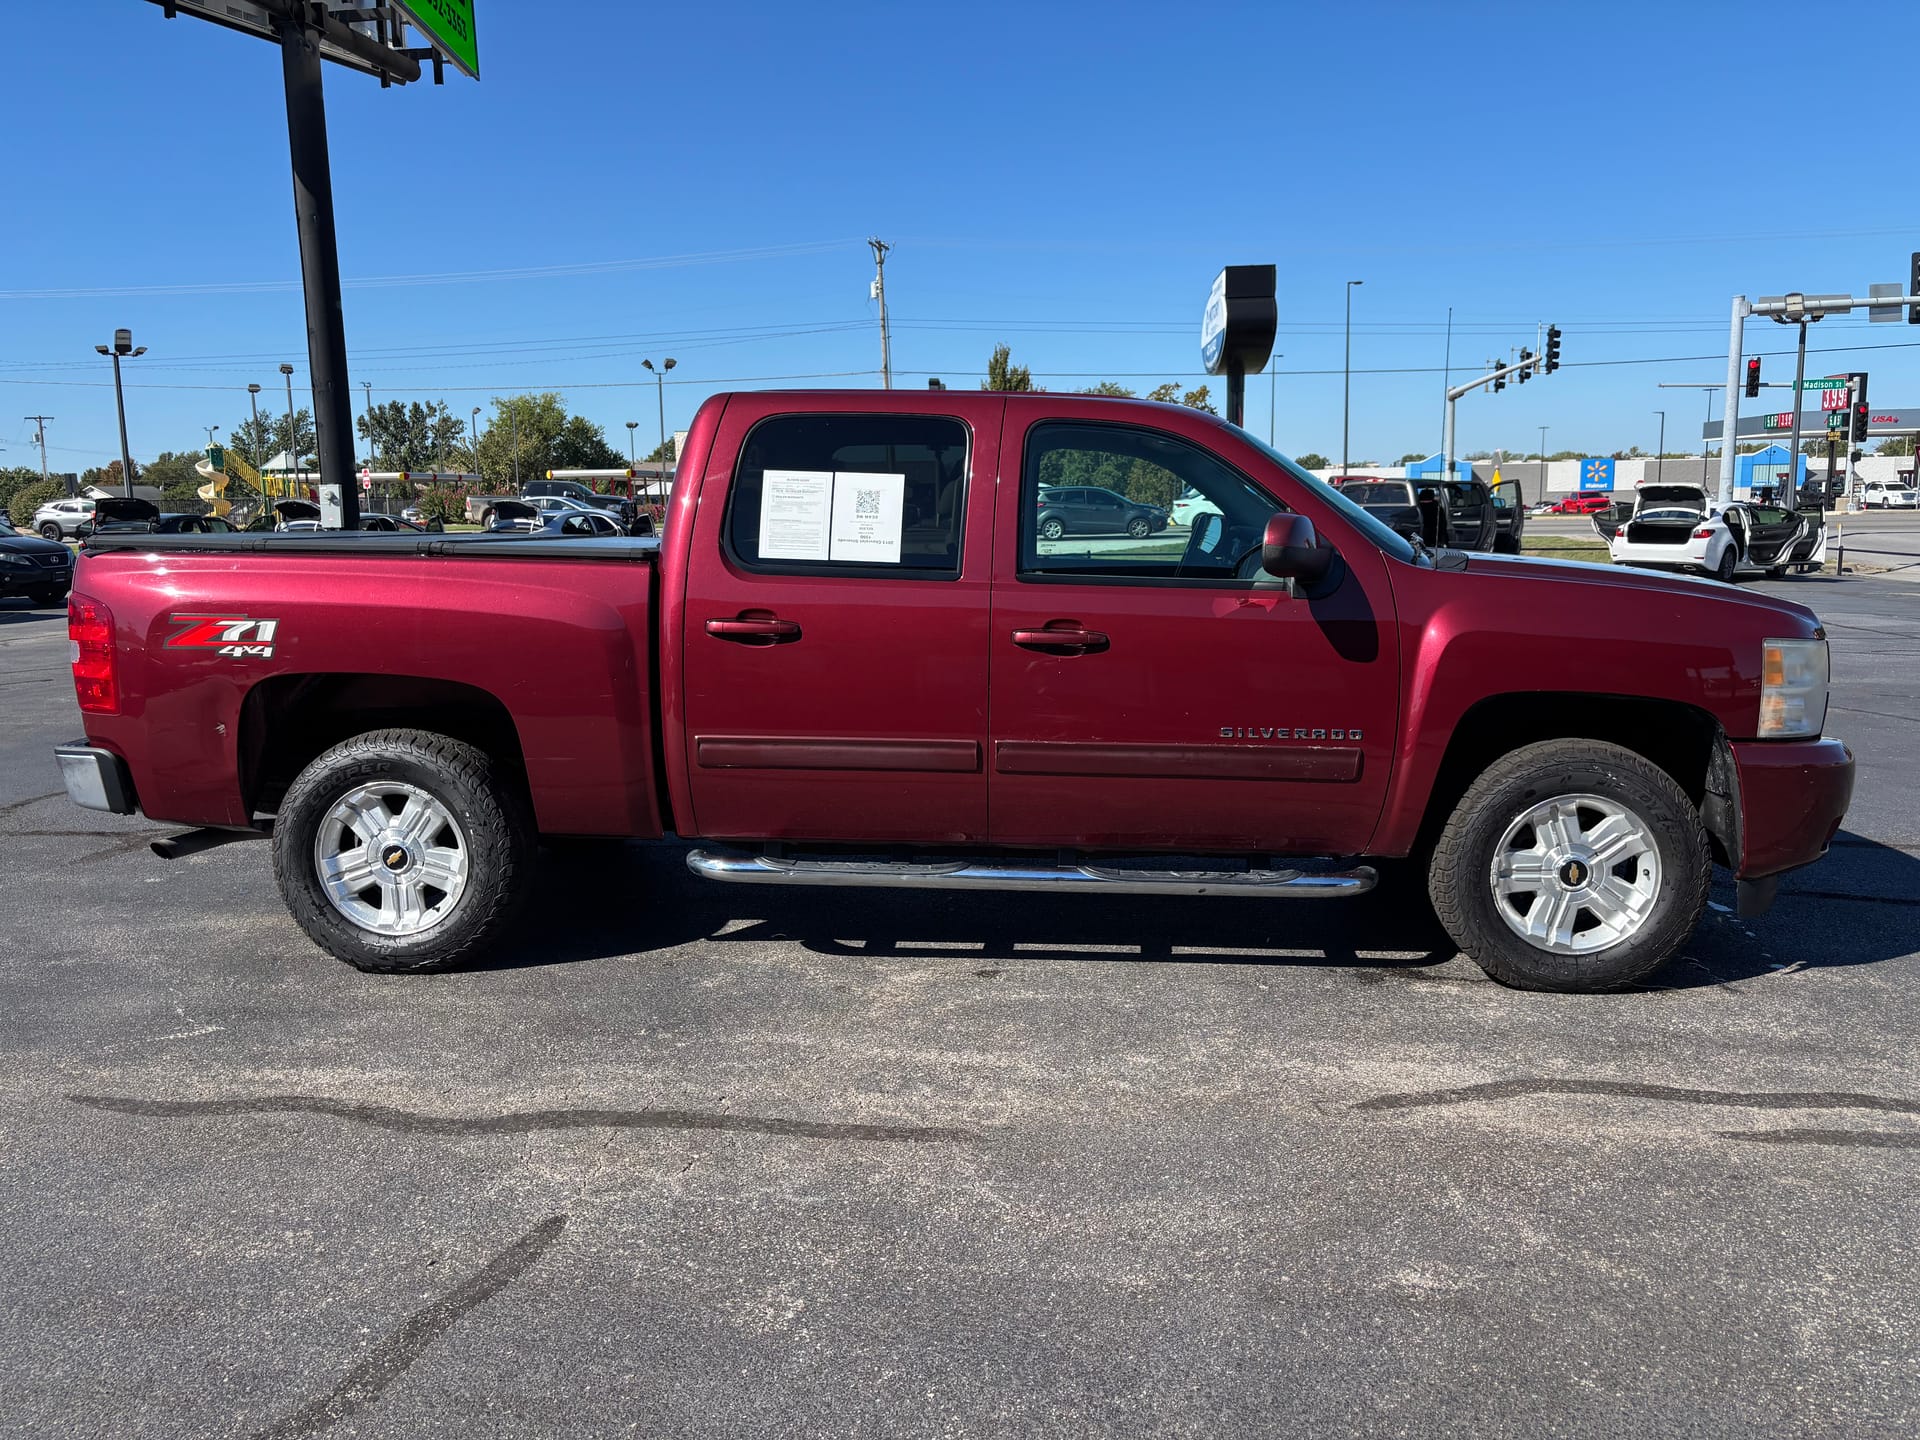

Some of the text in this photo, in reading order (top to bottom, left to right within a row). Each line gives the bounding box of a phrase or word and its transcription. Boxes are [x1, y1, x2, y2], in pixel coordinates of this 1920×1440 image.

[1803, 381, 1833, 389] Madison
[1872, 415, 1893, 423] USA
[164, 614, 278, 648] Z71
[1219, 727, 1364, 740] SILVERADO
[308, 762, 391, 803] COOPER
